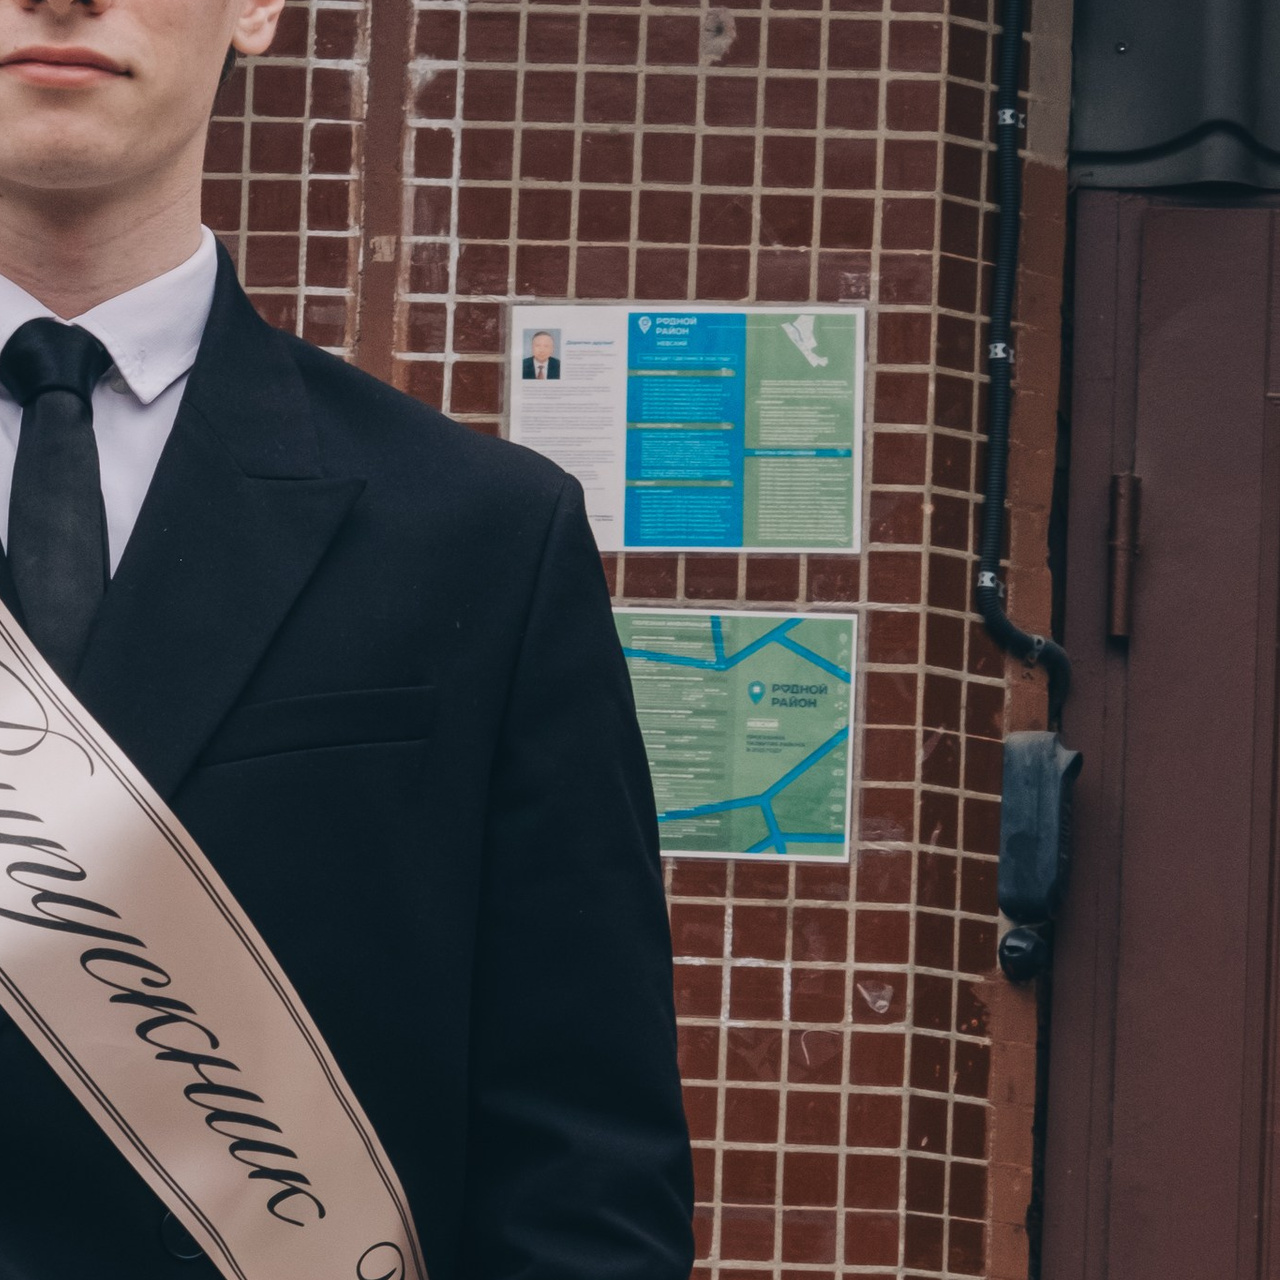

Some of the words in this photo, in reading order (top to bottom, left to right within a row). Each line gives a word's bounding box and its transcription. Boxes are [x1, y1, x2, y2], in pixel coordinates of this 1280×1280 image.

[656, 325, 689, 335] РАЙОН
[771, 683, 828, 695] РОДНОЙ
[771, 696, 817, 708] РАЙОН
